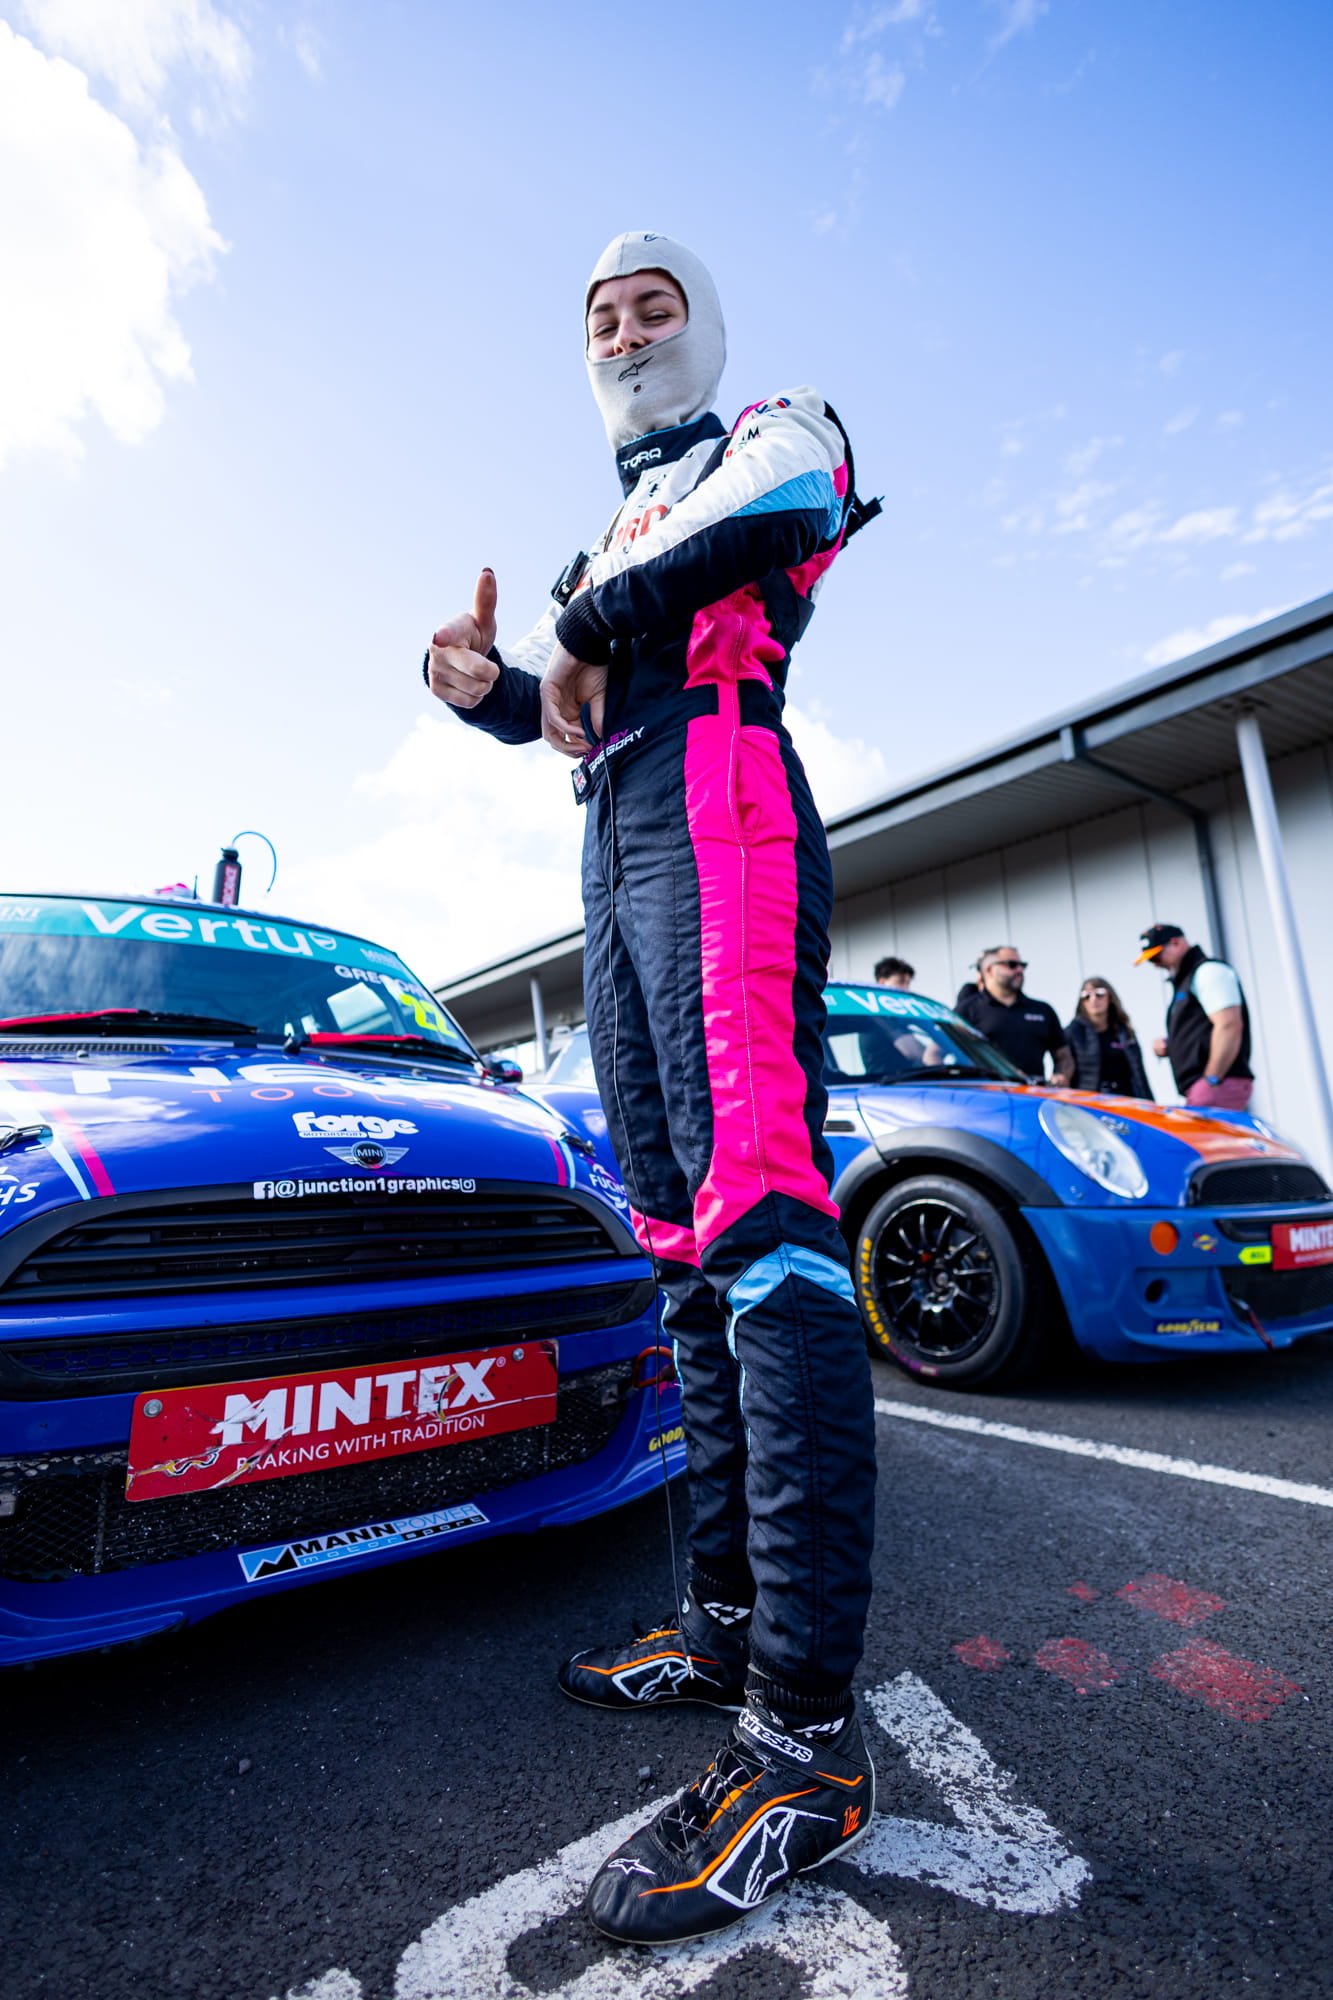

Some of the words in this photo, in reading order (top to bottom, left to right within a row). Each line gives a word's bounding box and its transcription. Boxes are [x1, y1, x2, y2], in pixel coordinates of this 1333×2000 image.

[620, 447, 662, 470] TORQ
[587, 726, 645, 774] GREGORY
[80, 903, 314, 957] Vertu
[334, 965, 432, 1000] GREOR
[192, 1085, 452, 1110] TOOLS
[292, 1111, 420, 1140] Forge
[356, 1148, 384, 1158] MINI
[334, 1432, 386, 1455] WITH
[390, 1413, 486, 1446] TRADITION
